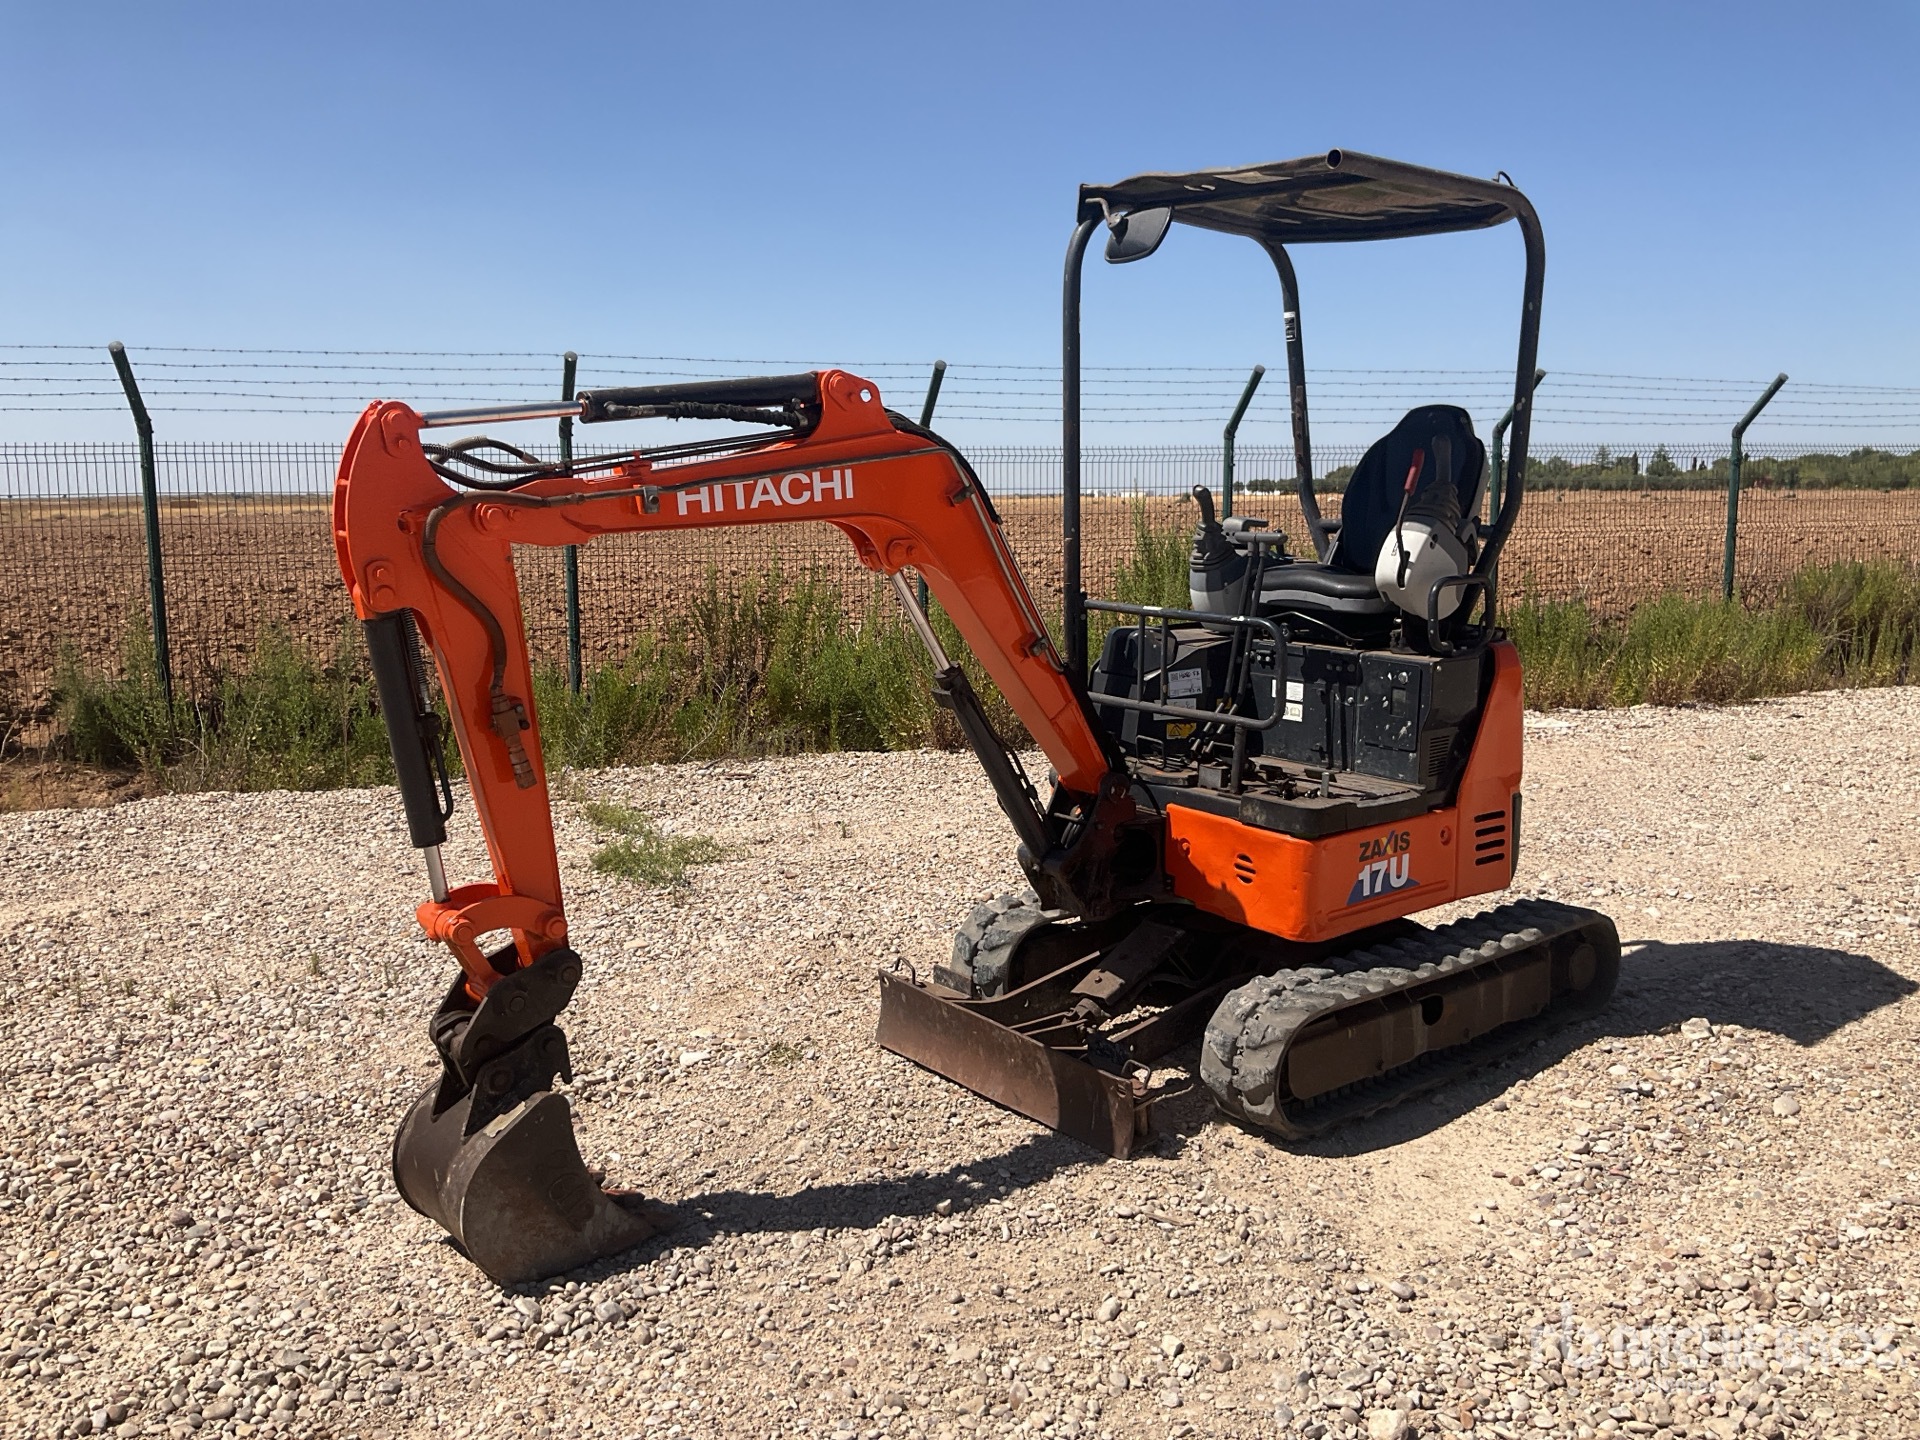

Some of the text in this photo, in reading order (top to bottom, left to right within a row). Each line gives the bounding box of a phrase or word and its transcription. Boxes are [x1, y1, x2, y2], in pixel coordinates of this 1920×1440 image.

[677, 469, 854, 515] HITACHI
[1359, 830, 1411, 862] ZAXIS
[1358, 853, 1410, 897] 17U
